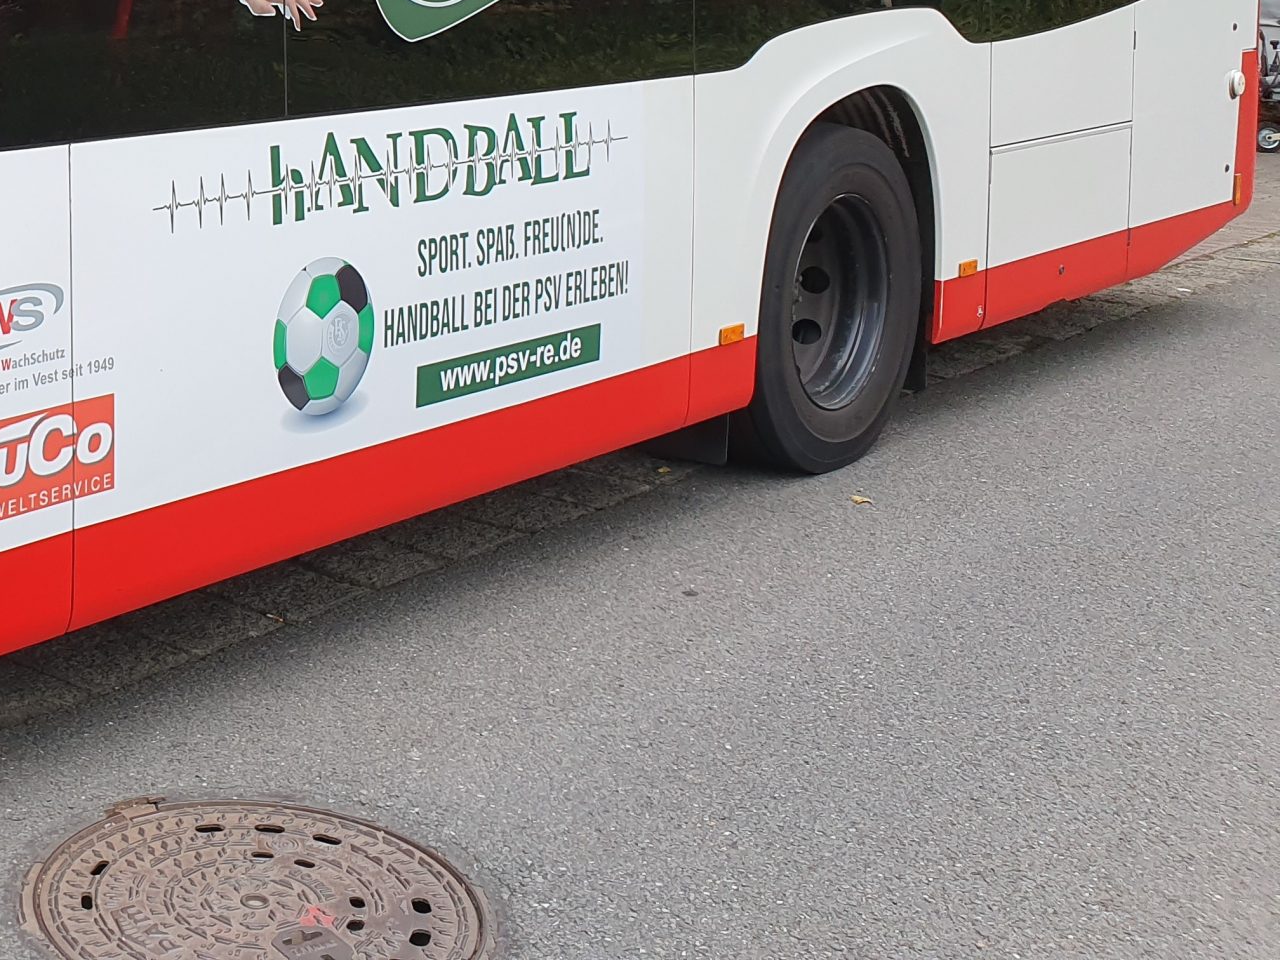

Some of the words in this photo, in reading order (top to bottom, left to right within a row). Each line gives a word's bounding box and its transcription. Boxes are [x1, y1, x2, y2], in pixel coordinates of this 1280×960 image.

[417, 232, 471, 278] SPORT.
[523, 209, 603, 257] FREU(N)DE.
[384, 295, 469, 348] HANDBALL
[474, 288, 497, 329] BEI
[501, 283, 531, 320] DER
[535, 275, 561, 313] PSV
[565, 260, 629, 307] ERLEBEN!
[1, 347, 65, 371] WachSchutz
[14, 377, 29, 391] im
[32, 368, 59, 386] Vest
[62, 362, 83, 380] seit
[86, 356, 114, 375] 1949
[439, 332, 582, 392] www.psv-re.de
